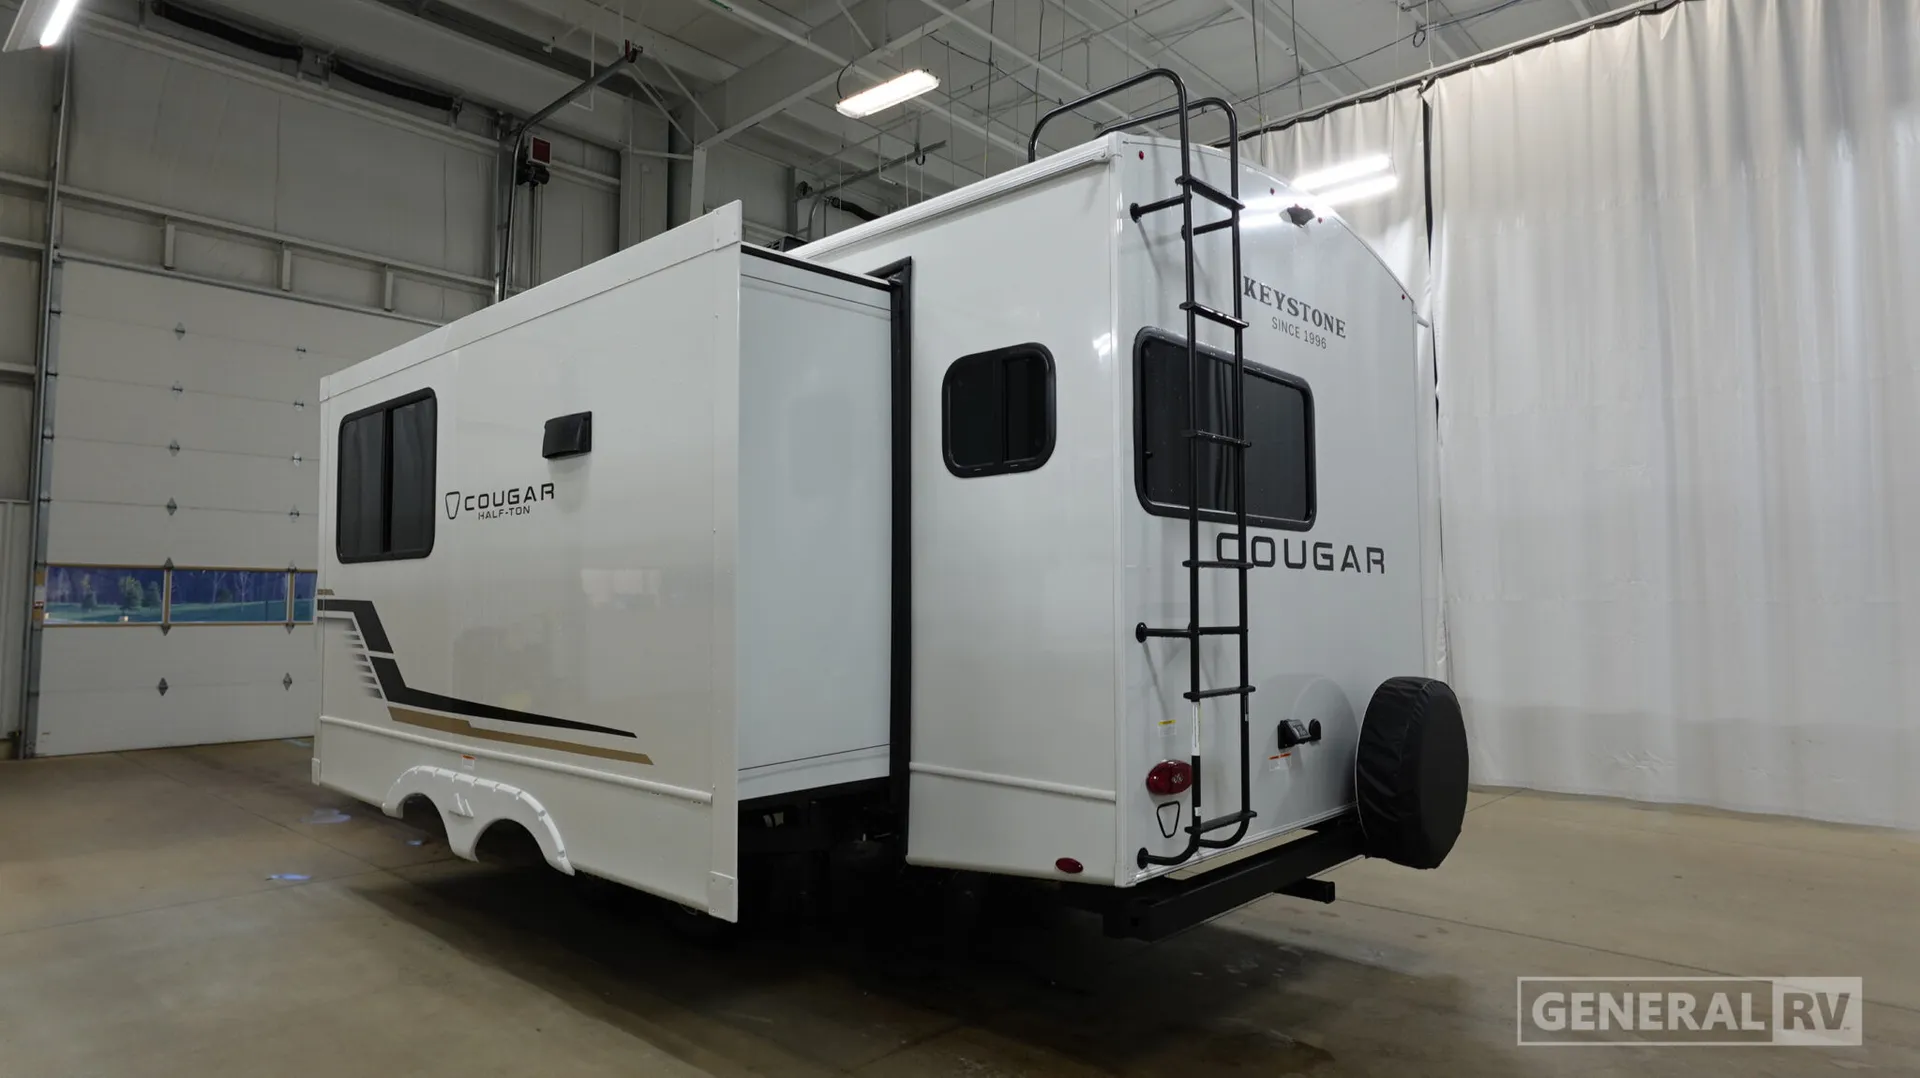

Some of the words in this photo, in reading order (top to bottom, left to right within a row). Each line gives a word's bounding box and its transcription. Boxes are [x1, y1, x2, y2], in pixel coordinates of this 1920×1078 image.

[1243, 275, 1346, 339] KEYSTONE
[1271, 316, 1301, 340] SINCE
[1303, 330, 1327, 350] 1996
[464, 482, 555, 511] COUGAR
[478, 505, 530, 520] HALF-TON
[1216, 532, 1386, 575] COUGAR
